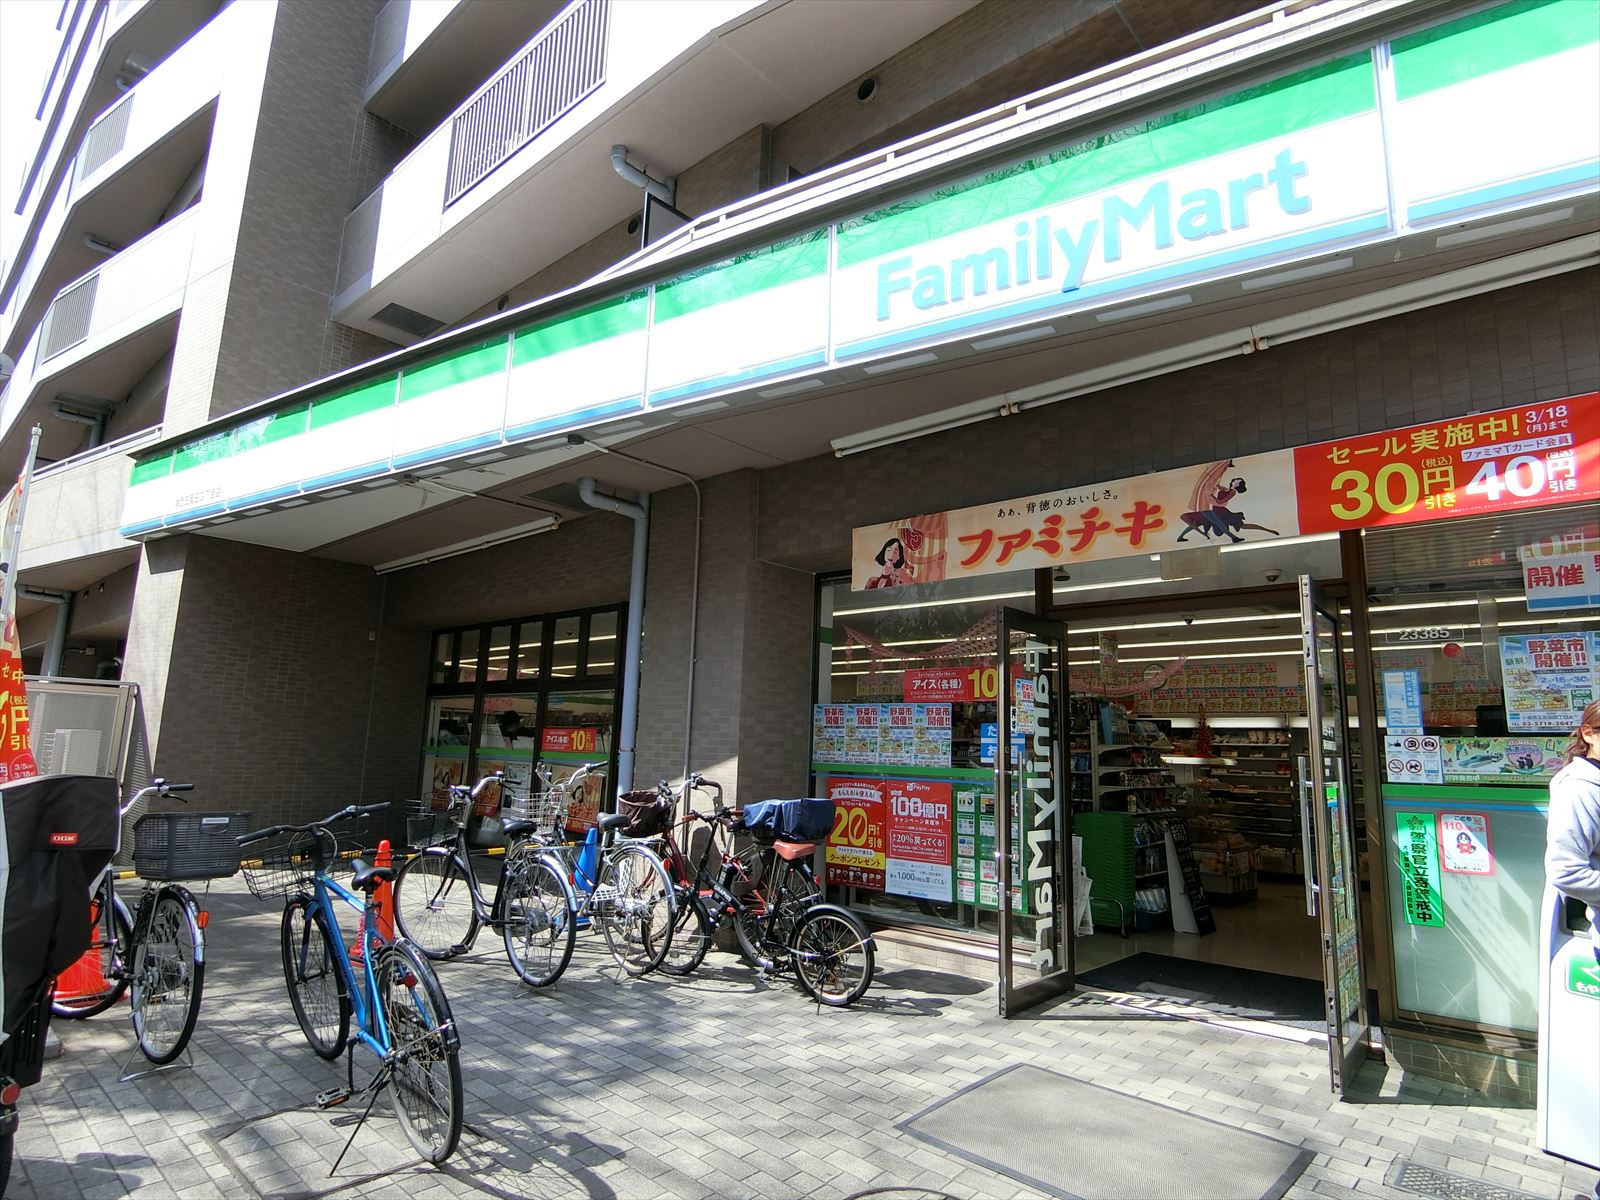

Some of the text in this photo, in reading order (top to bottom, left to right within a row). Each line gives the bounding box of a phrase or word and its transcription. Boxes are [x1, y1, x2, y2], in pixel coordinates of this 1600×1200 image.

[877, 148, 1312, 321] FamilyMart
[1526, 405, 1567, 423] 3/18
[1327, 414, 1519, 465] セール実施中!
[1463, 435, 1572, 460] ファミマTカード会員
[1465, 455, 1546, 501] 40
[1330, 462, 1419, 521] 30
[1424, 494, 1457, 510] 引き
[997, 489, 1120, 519] あぁ、背徳のおいしさ。
[958, 501, 1168, 568] ファミチキ
[1528, 564, 1585, 588] 開催
[1400, 627, 1450, 641] 23385
[1527, 638, 1584, 654] 野菜市
[1534, 653, 1588, 668] 開催!!
[913, 678, 962, 690] アイス(各種)
[890, 796, 948, 820] 100億円
[1410, 831, 1432, 922] 警察官立寄警戒中
